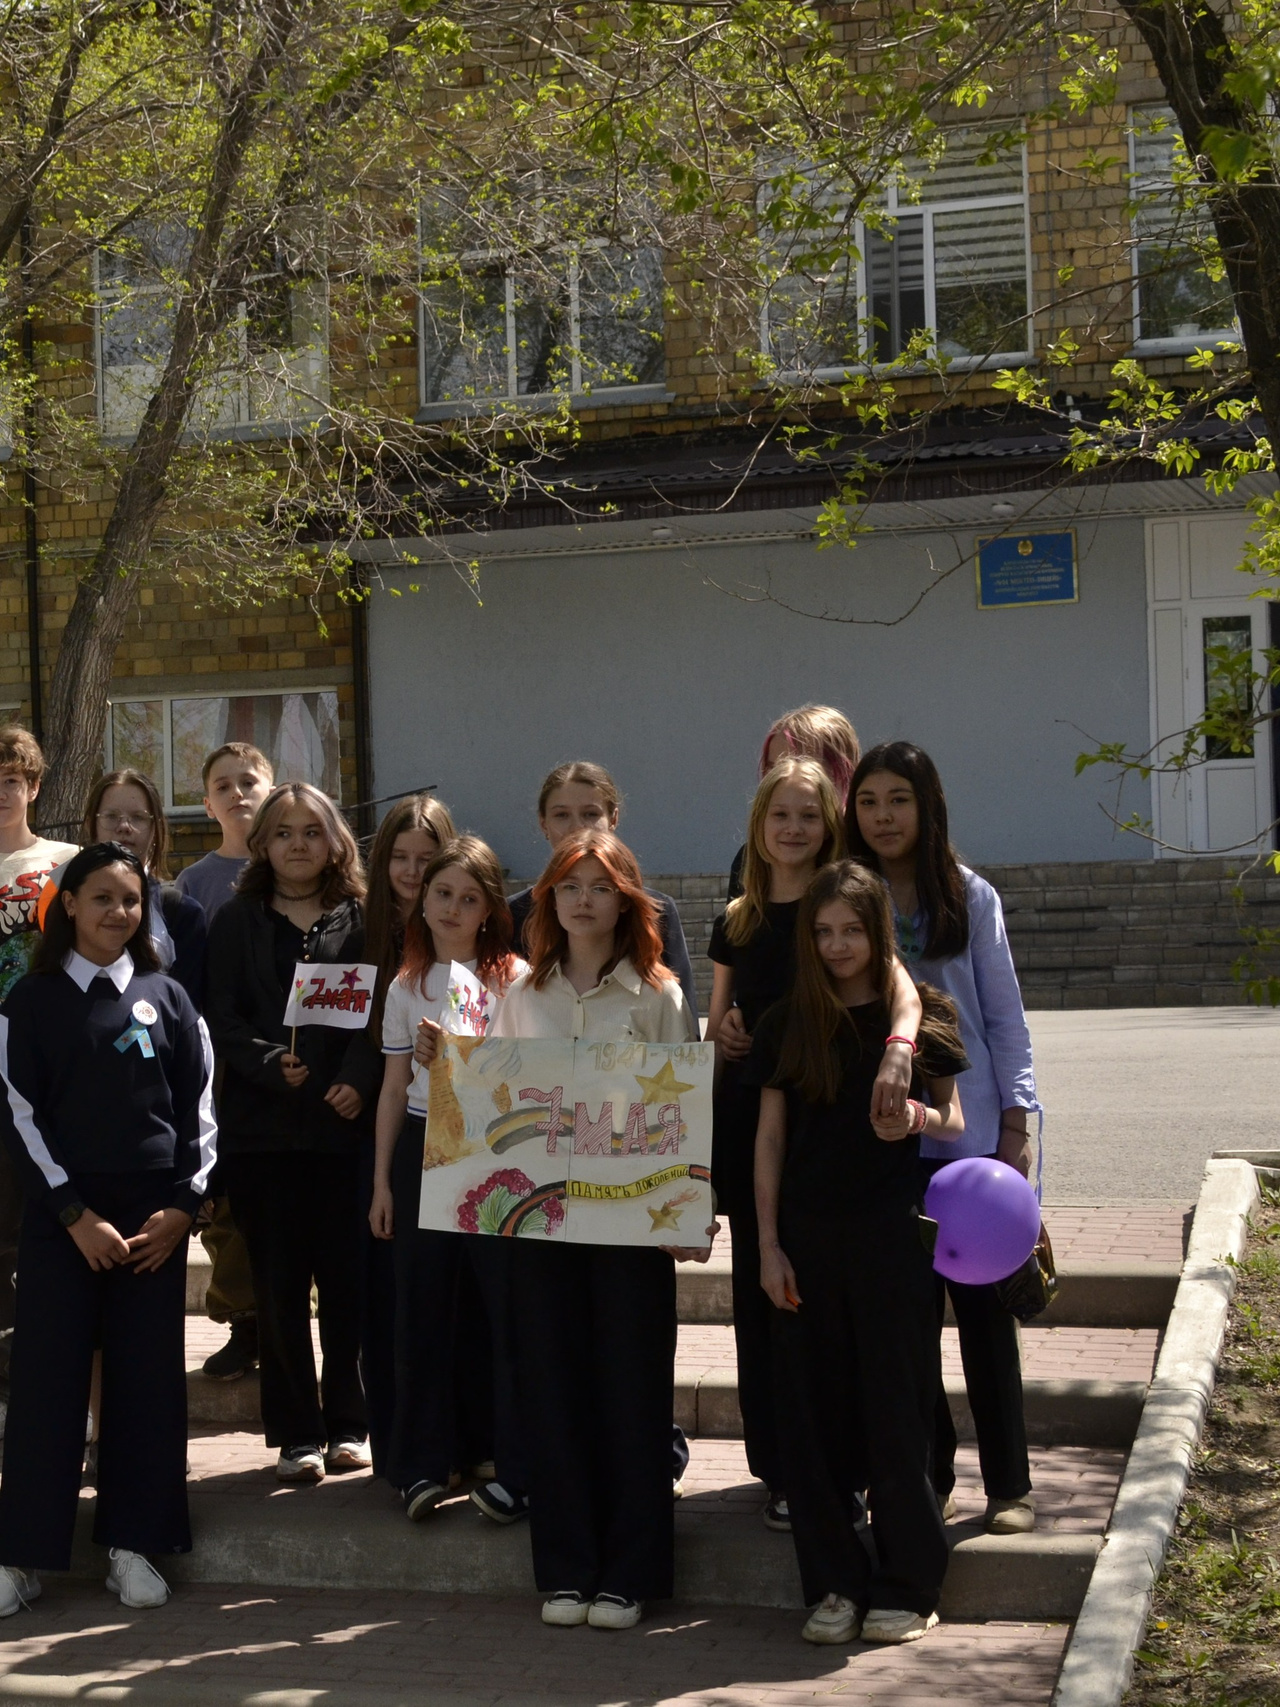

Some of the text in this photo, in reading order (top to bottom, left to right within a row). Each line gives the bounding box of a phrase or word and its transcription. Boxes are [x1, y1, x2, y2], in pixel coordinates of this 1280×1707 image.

[518, 1086, 680, 1155] 7 МАЯ
[571, 1181, 630, 1199] ПАМЯТЬ
